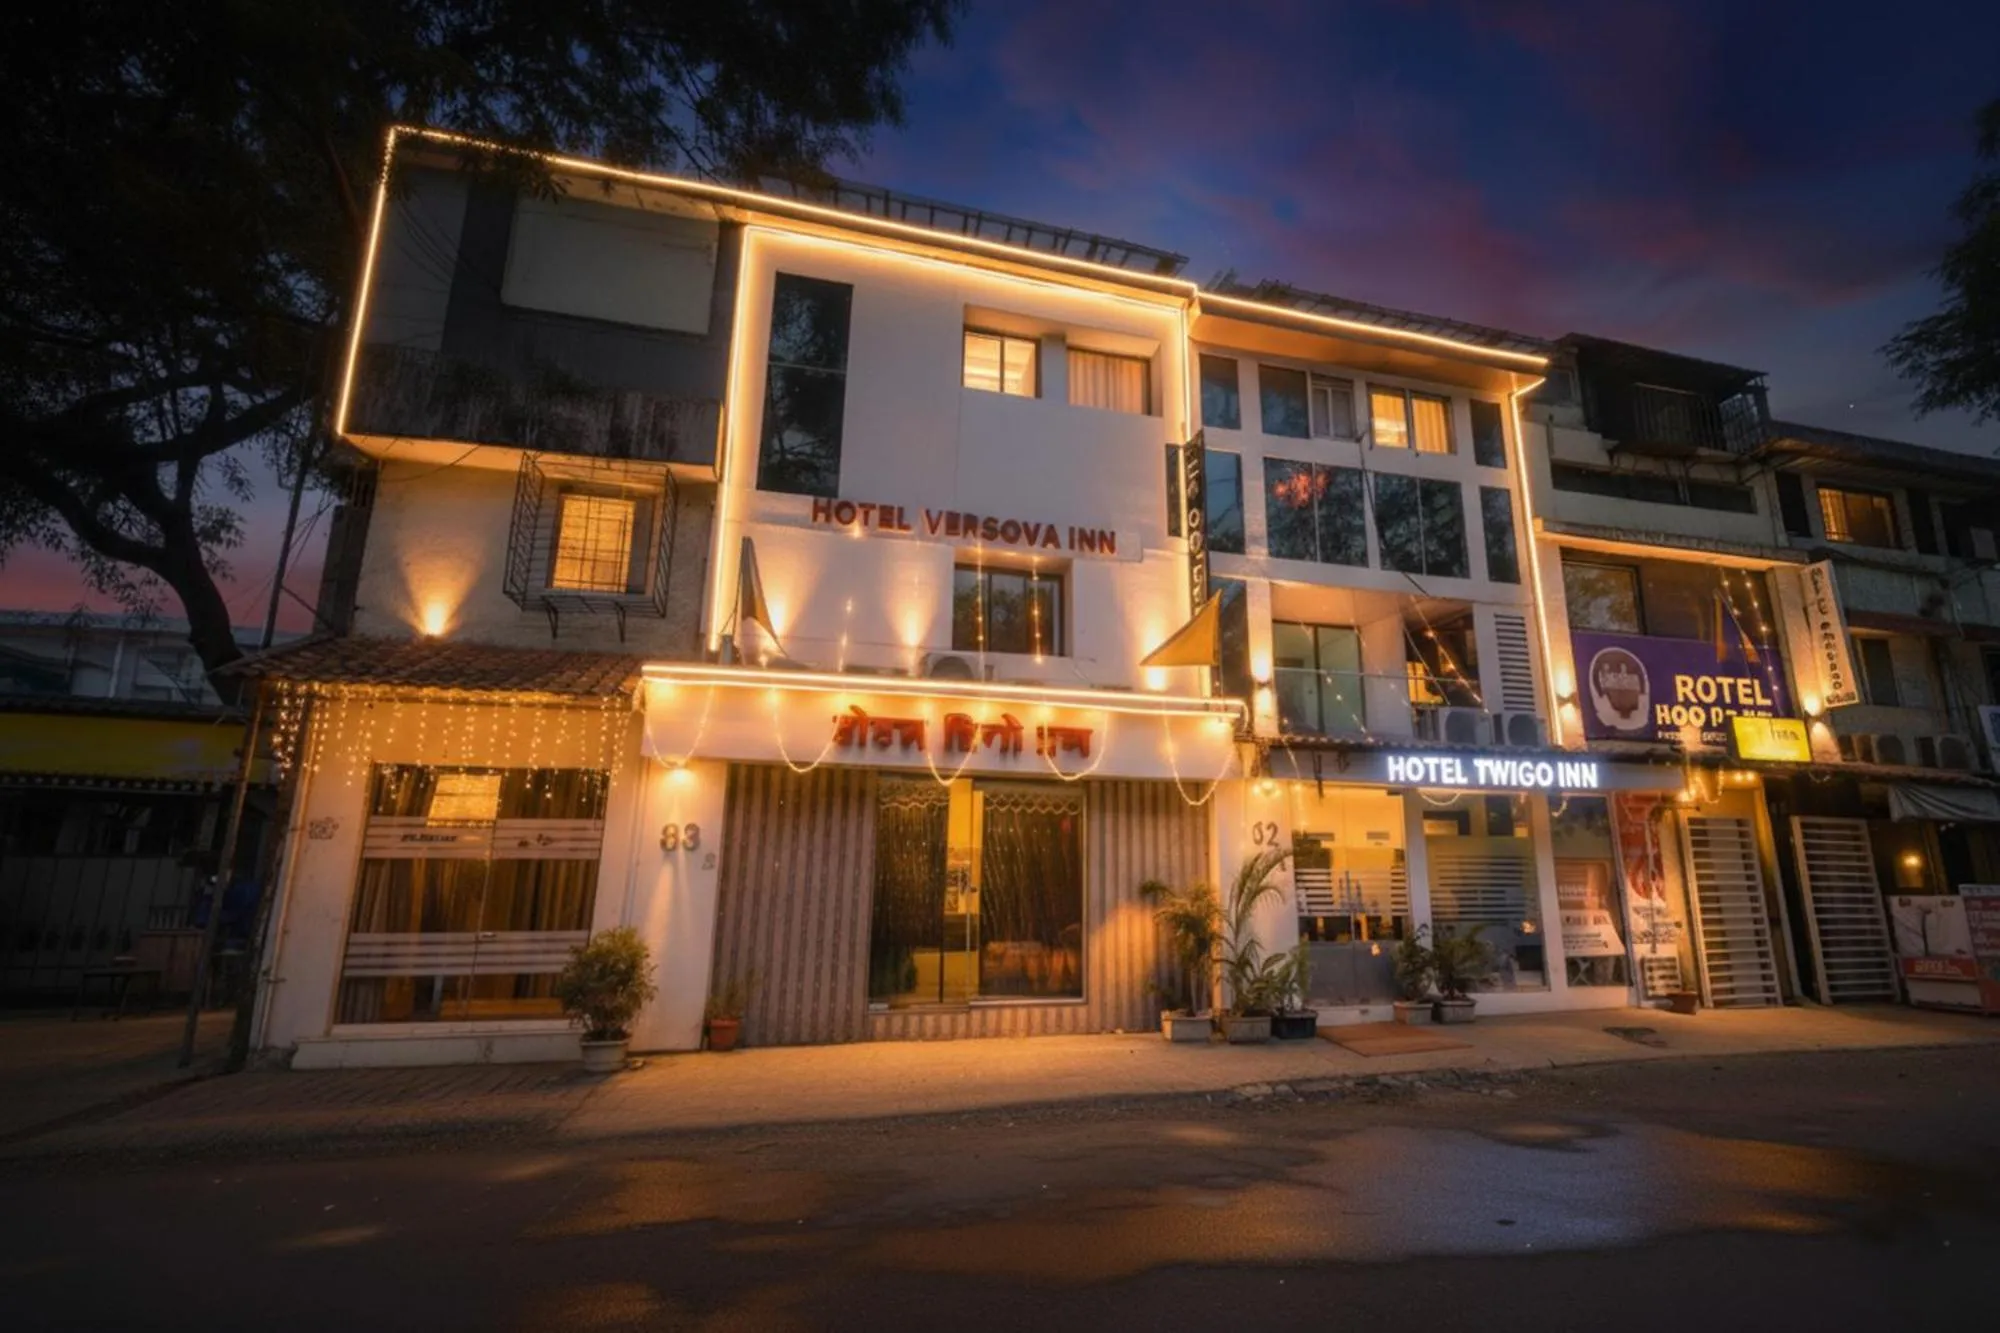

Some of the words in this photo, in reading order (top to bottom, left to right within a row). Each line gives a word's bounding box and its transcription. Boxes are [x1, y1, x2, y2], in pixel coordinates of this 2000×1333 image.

[812, 499, 912, 531] HOTEL
[925, 508, 1061, 549] VERSOVA
[1068, 526, 1116, 554] INN
[1675, 674, 1773, 706] ROTEL
[1387, 755, 1468, 785] HOTEL
[1473, 758, 1554, 788] TWIGO
[1557, 761, 1599, 789] INN
[660, 823, 701, 852] 83
